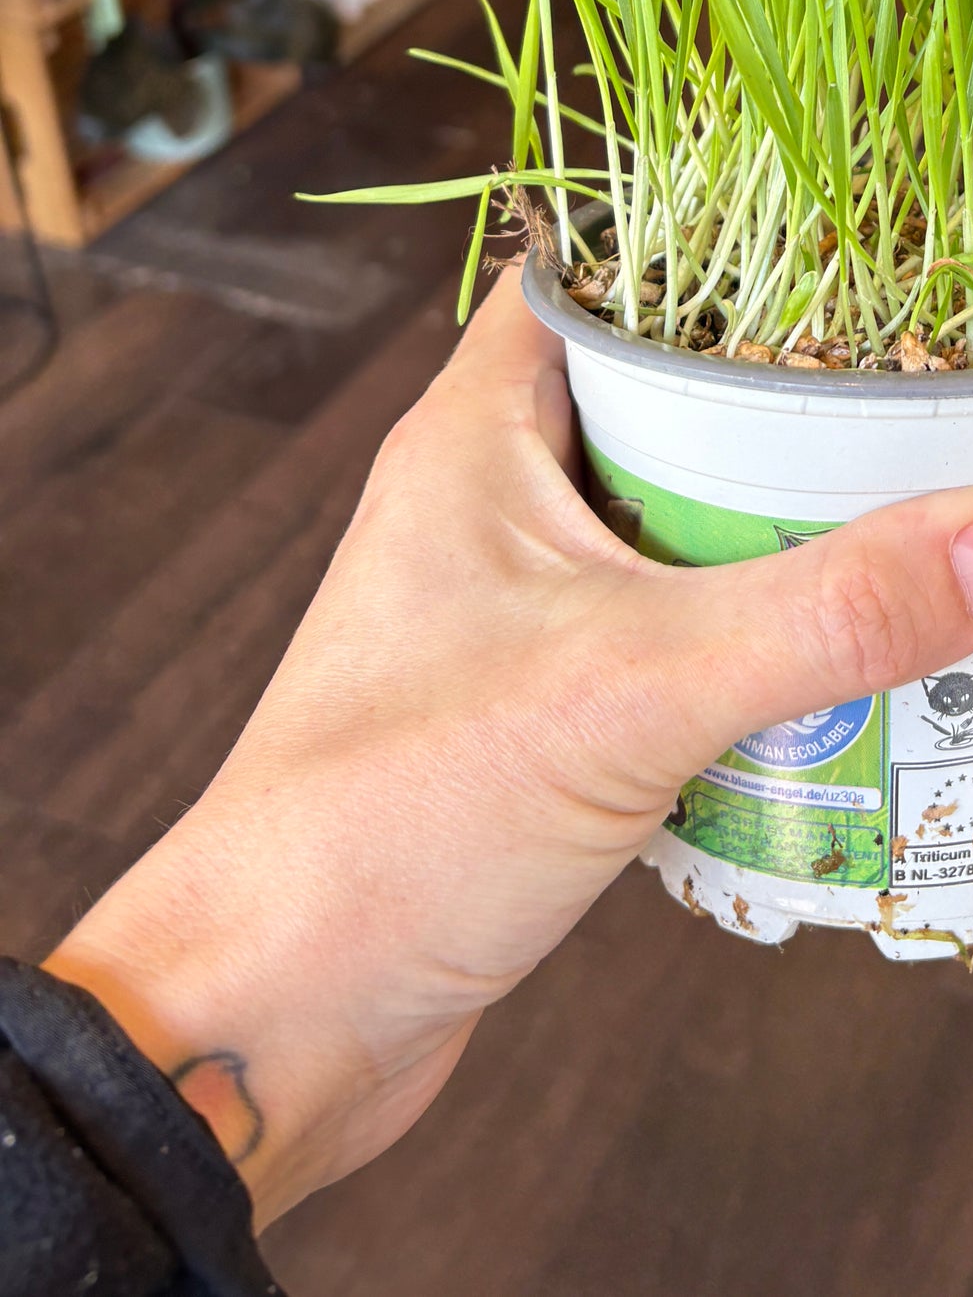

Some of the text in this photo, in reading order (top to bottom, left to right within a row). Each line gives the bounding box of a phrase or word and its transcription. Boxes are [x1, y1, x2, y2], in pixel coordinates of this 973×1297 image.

[741, 719, 855, 761] RMAN ECOLABEL
[703, 767, 865, 805] www.blauer-engel.de/uz30a
[911, 848, 971, 864] Triticum
[894, 869, 906, 882] B
